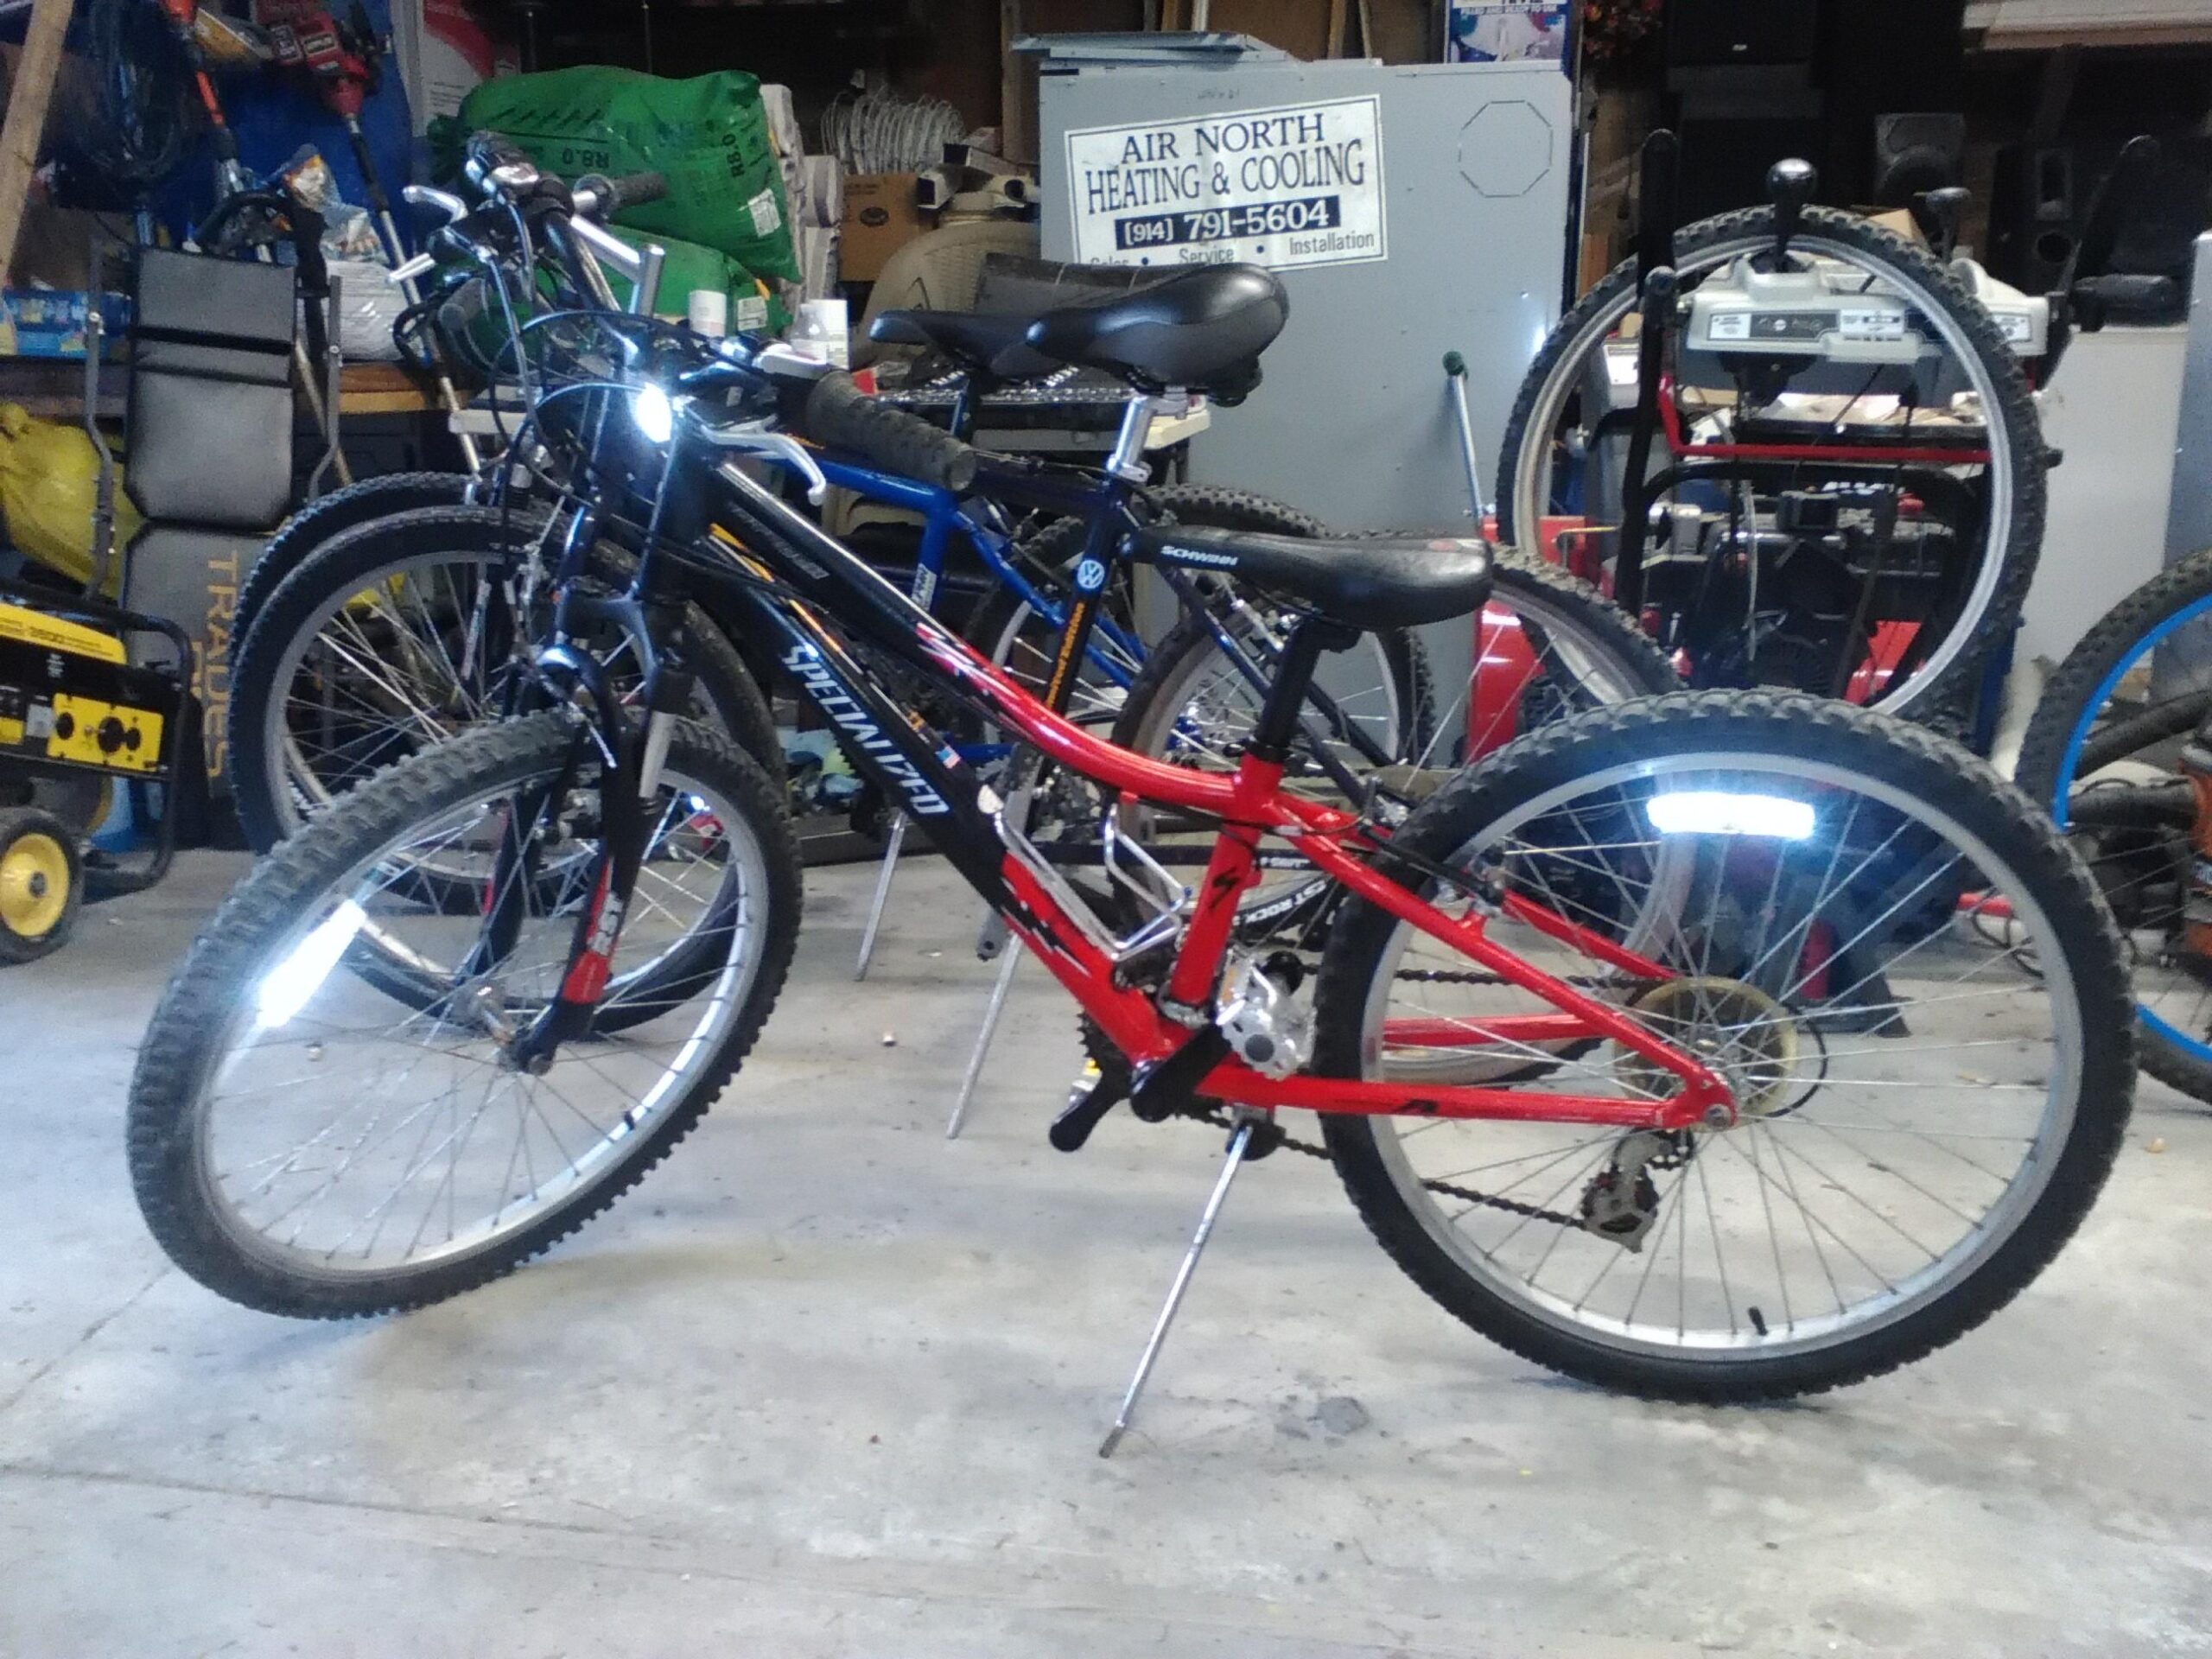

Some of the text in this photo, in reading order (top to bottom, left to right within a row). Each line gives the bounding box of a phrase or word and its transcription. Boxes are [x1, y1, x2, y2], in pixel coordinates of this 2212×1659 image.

[1122, 113, 1325, 165] AIR NORTH
[1085, 139, 1364, 215] HEATING & COOLING
[1184, 199, 1330, 240] 791-5604
[1179, 230, 1375, 264] Service Installation
[1160, 545, 1238, 566] SCHWINN
[781, 645, 950, 814] SPECIALIZED
